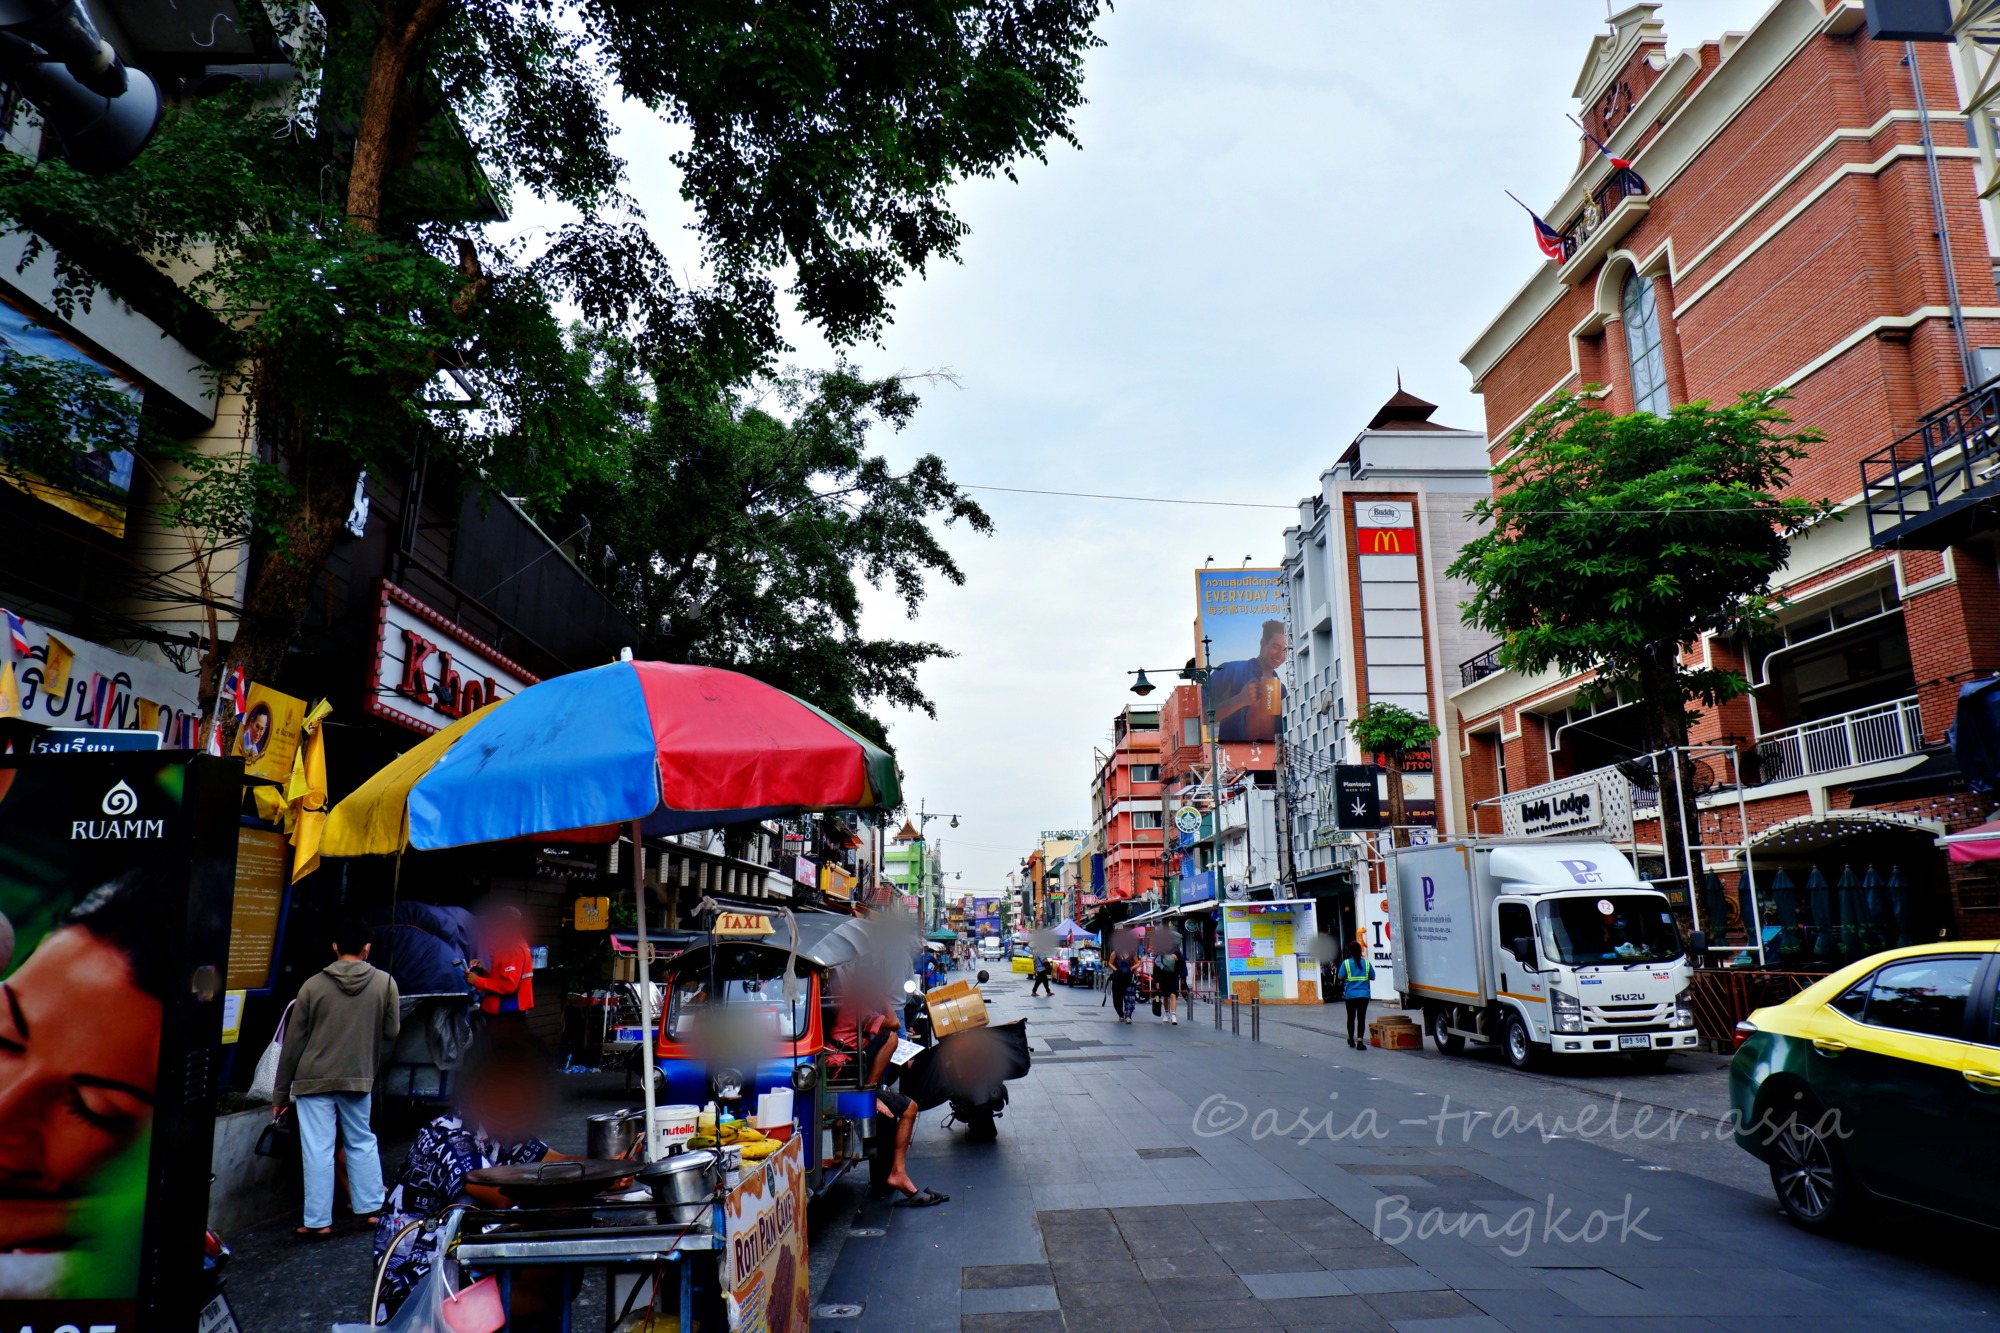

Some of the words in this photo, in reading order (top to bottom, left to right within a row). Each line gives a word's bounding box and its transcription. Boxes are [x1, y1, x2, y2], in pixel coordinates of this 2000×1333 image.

[1205, 590, 1268, 603] EVERYDAY
[1521, 800, 1550, 822] Buddy
[1552, 792, 1590, 816] Lodge
[70, 819, 165, 840] RUAMM
[1541, 820, 1569, 832] Boutique
[1040, 830, 1088, 838] KHAOSAN
[1600, 902, 1611, 911] T2
[723, 914, 761, 929] TAXI
[1611, 993, 1645, 1001] ISUZU
[663, 1124, 694, 1136] nutella
[734, 1231, 759, 1283] ROTI
[758, 1215, 776, 1256] PAN
[776, 1193, 792, 1235] CAKE
